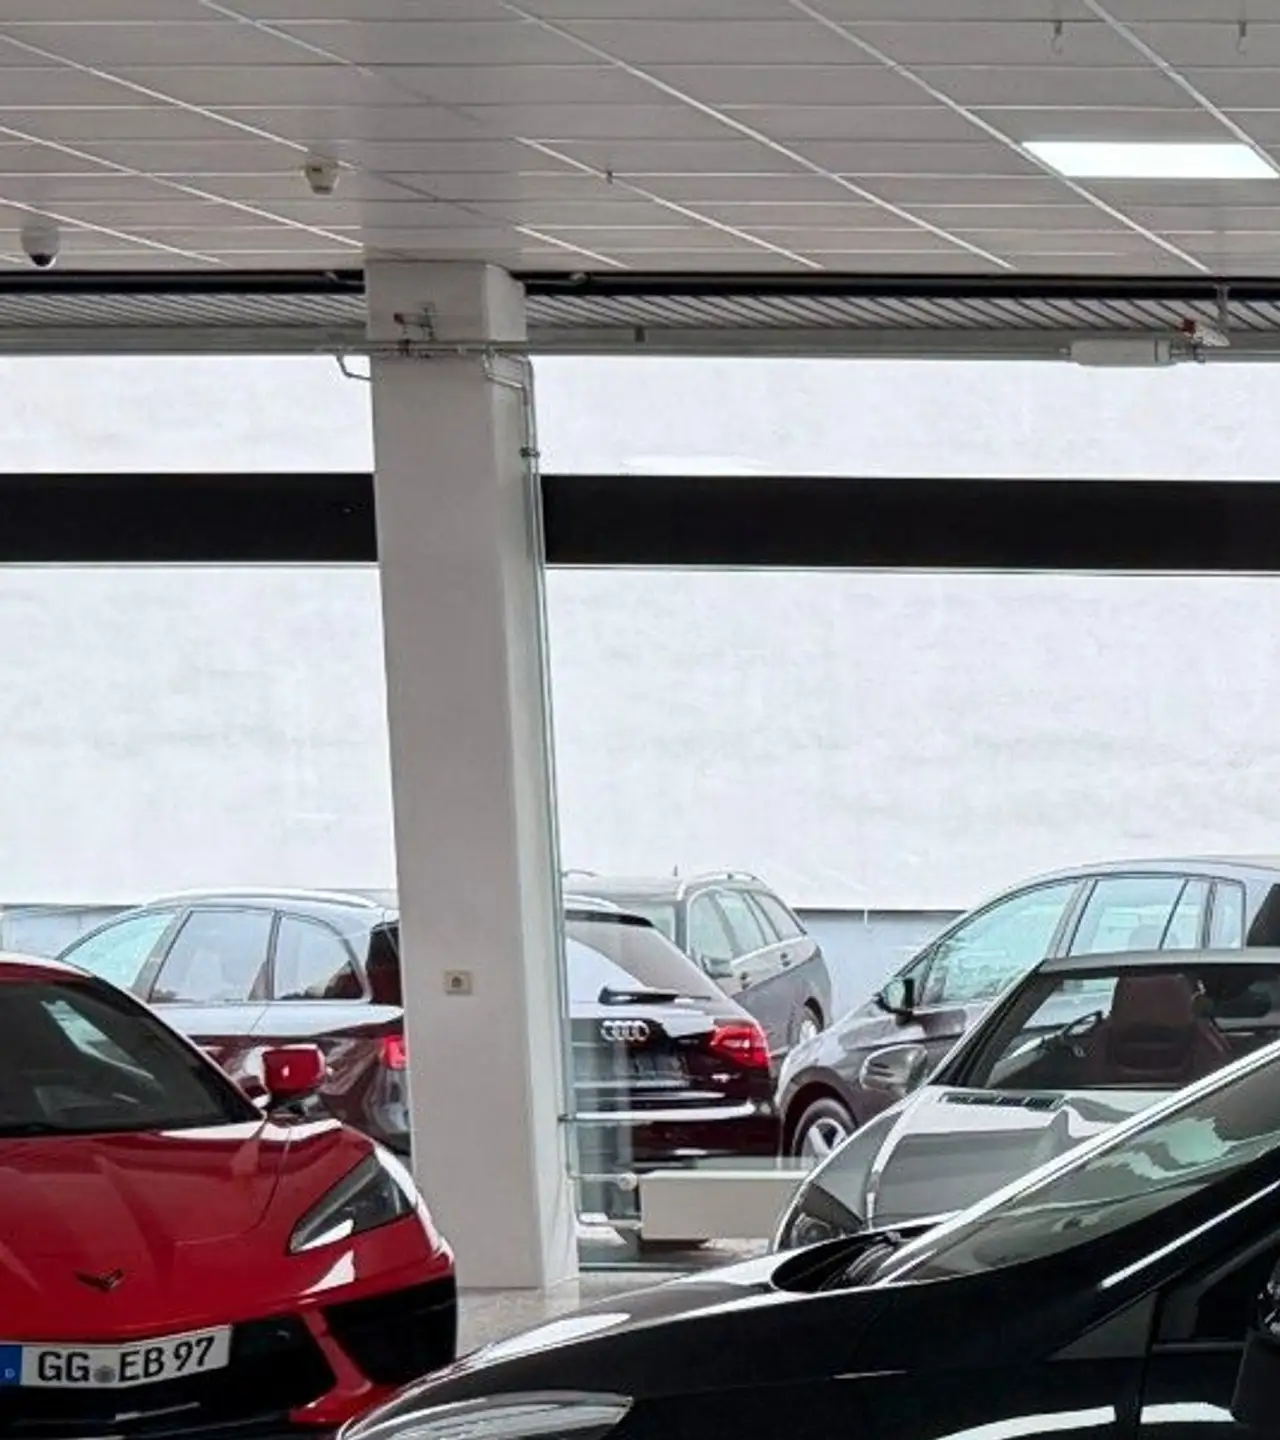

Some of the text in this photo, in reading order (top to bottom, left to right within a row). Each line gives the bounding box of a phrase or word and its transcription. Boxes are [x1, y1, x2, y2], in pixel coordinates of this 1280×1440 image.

[38, 1336, 215, 1382] GG EB 97
